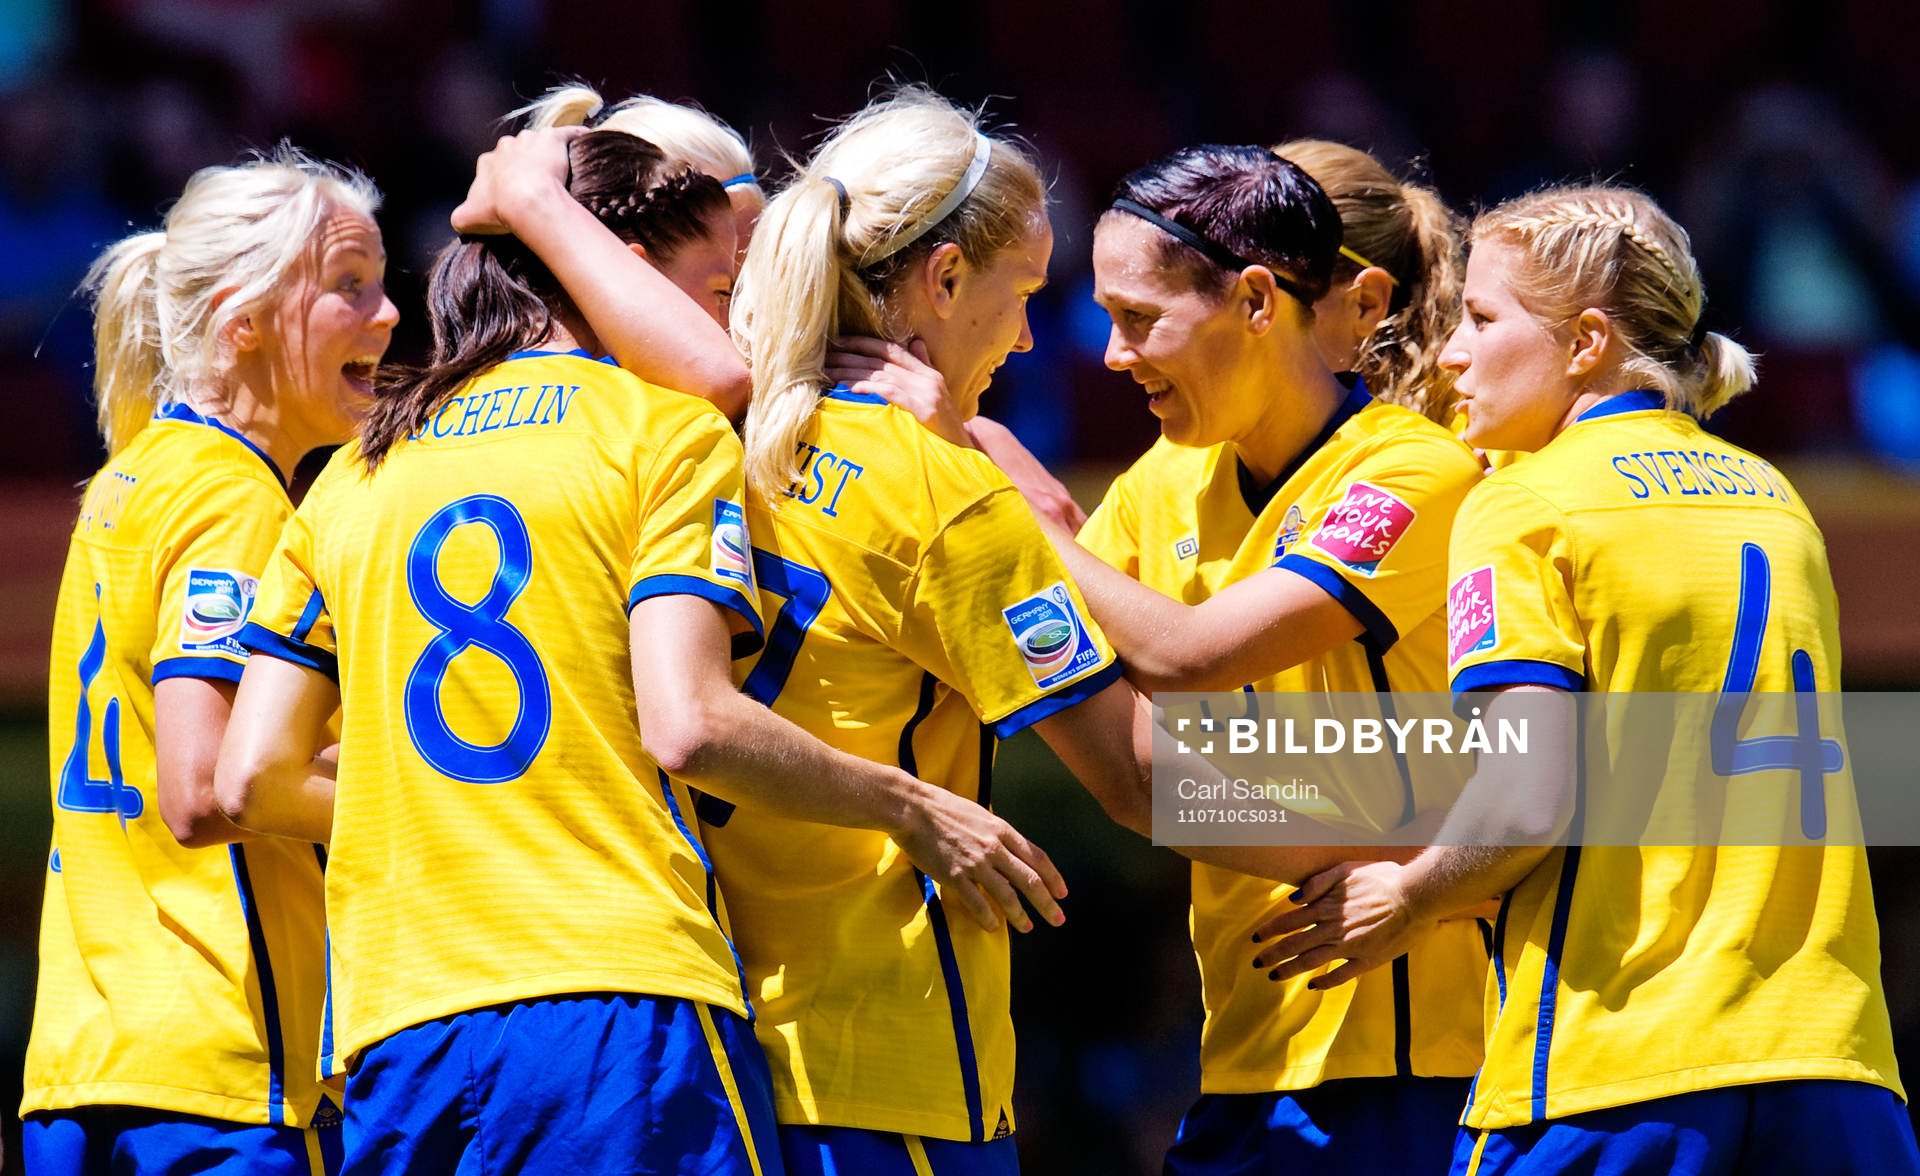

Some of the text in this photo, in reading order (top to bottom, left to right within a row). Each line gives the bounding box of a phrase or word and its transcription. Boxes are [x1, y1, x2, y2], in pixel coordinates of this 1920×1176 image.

[1343, 493, 1397, 514] LIVE
[1334, 505, 1393, 538] YOUR
[1320, 524, 1390, 555] GOALS
[1010, 602, 1049, 624] GERMANY
[1038, 609, 1053, 621] 2011
[404, 493, 552, 784] 8
[1075, 648, 1096, 664] FIFA
[1710, 541, 1843, 840] 4
